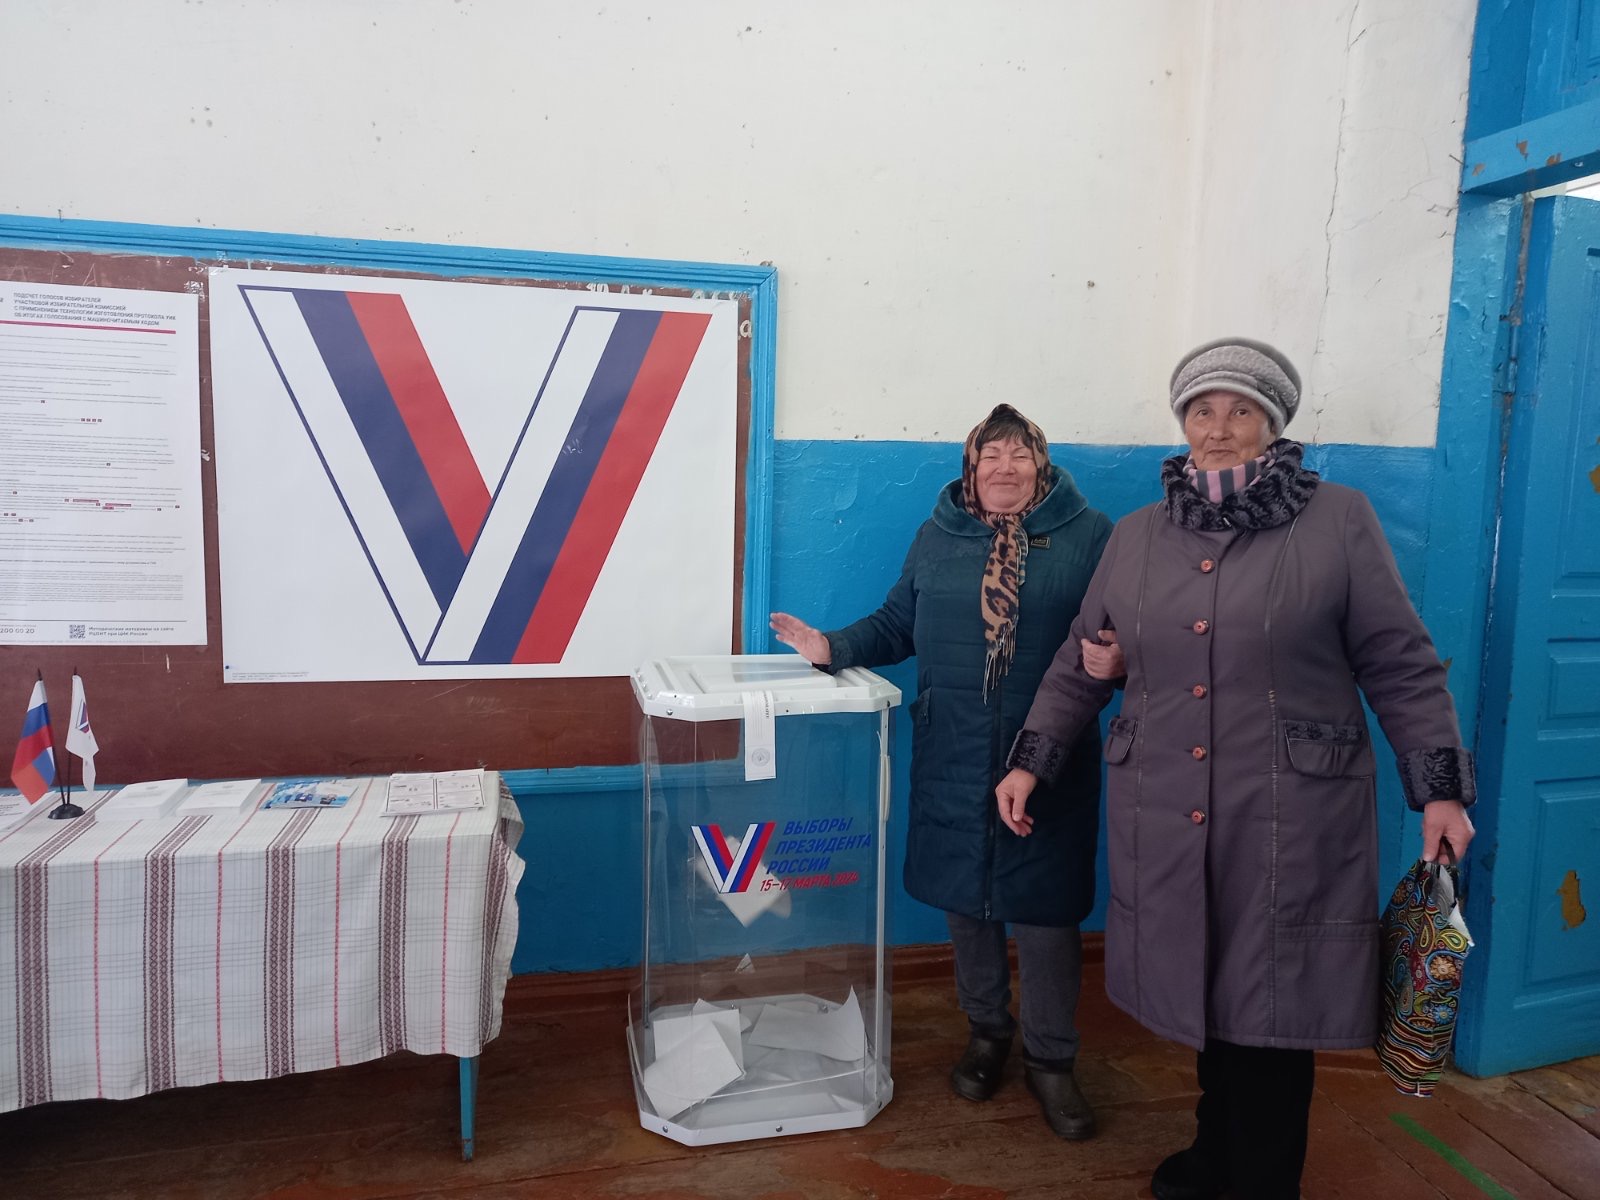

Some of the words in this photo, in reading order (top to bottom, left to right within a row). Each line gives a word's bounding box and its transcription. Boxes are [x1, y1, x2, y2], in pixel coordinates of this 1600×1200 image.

[50, 301, 94, 309] ИЗБИРАТЕЛЬНОЙ
[60, 308, 93, 316] ТЕХНОЛОГИИ
[94, 310, 133, 318] ИЗГОТОВЛЕНИЯ
[87, 317, 140, 325] МАШИНОЧИТАЕМЫМ
[782, 817, 854, 836] ВЫБОРЫ
[775, 833, 872, 855] ПРЕЗИДЕНТА
[766, 856, 831, 875] РОССИИ
[793, 873, 831, 889] МАРТА
[832, 871, 859, 887] 2024
